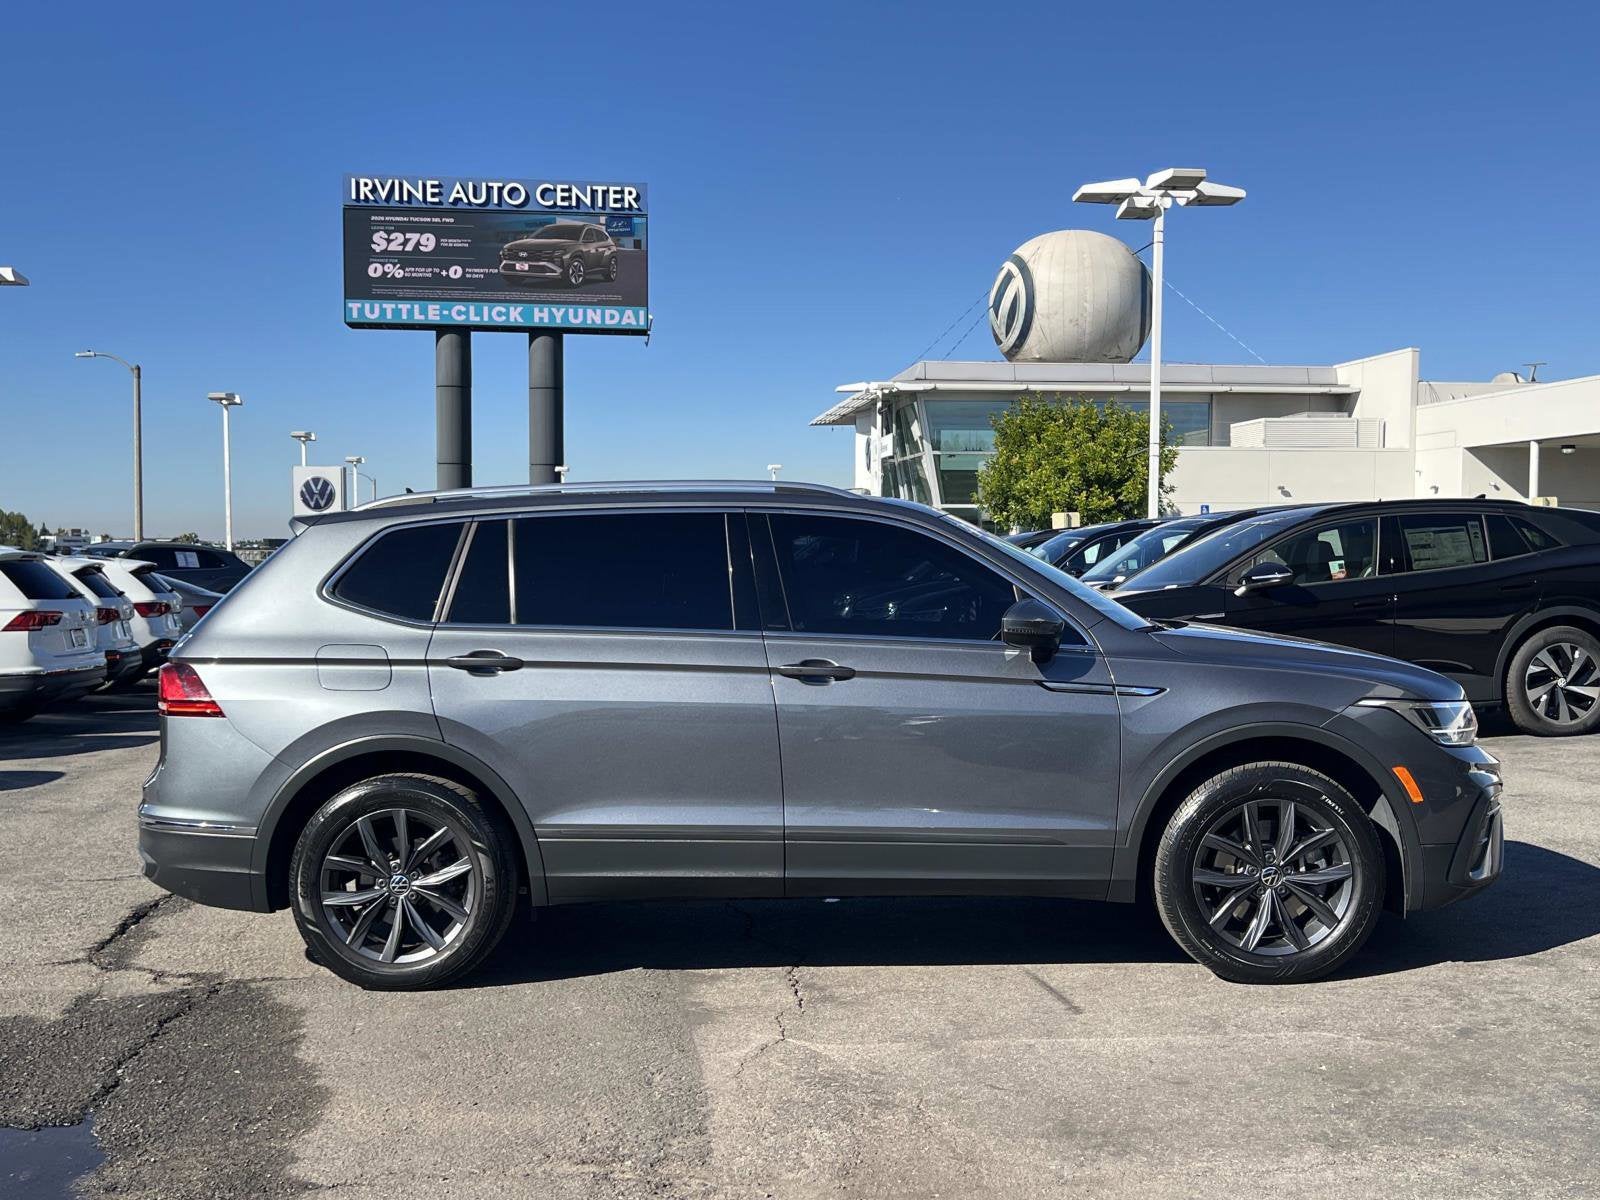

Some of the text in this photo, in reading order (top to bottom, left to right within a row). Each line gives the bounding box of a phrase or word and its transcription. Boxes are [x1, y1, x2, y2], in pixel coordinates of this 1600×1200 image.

[351, 178, 639, 209] IRVINE AUTO CENTER
[370, 230, 436, 253] $279
[367, 263, 404, 278] 0%
[347, 302, 645, 326] TUTTLE-CLICK HYUNDAI
